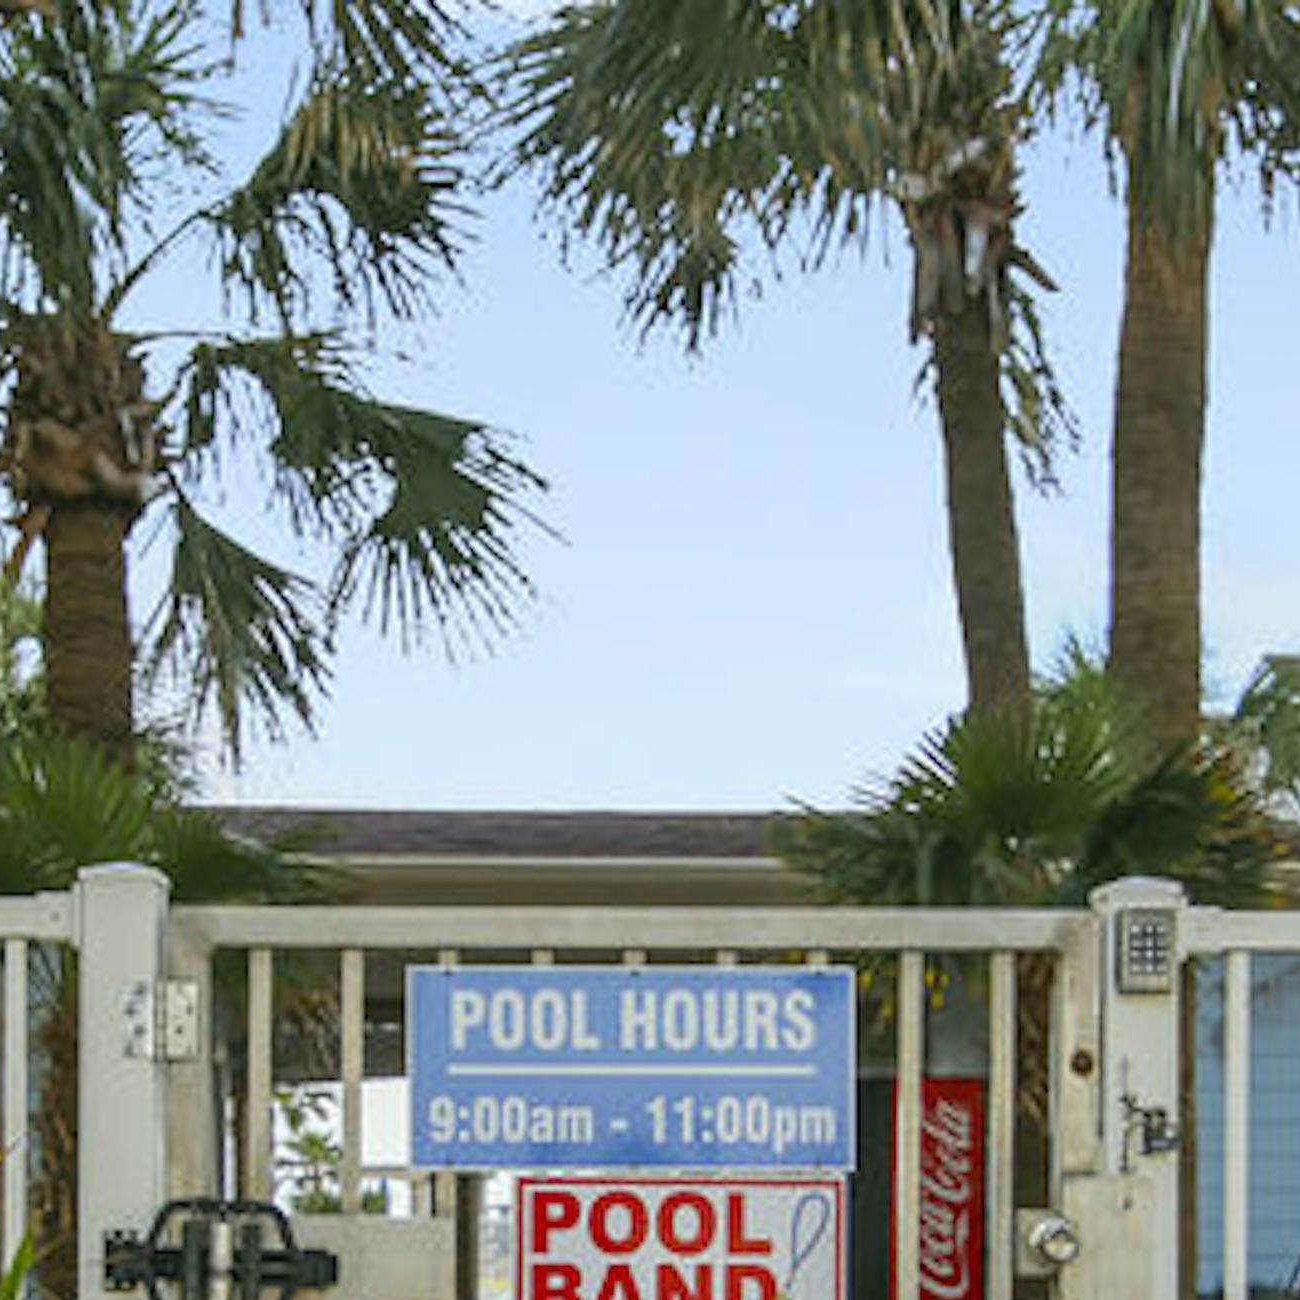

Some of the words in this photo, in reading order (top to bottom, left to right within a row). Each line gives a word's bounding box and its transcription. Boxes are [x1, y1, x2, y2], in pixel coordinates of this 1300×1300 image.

[450, 988, 600, 1051] POOL
[620, 988, 816, 1052] HOURS
[428, 1095, 594, 1144] 9:00am
[609, 1119, 629, 1132] -
[646, 1095, 836, 1153] 11:00pm
[531, 1191, 772, 1255] POOL
